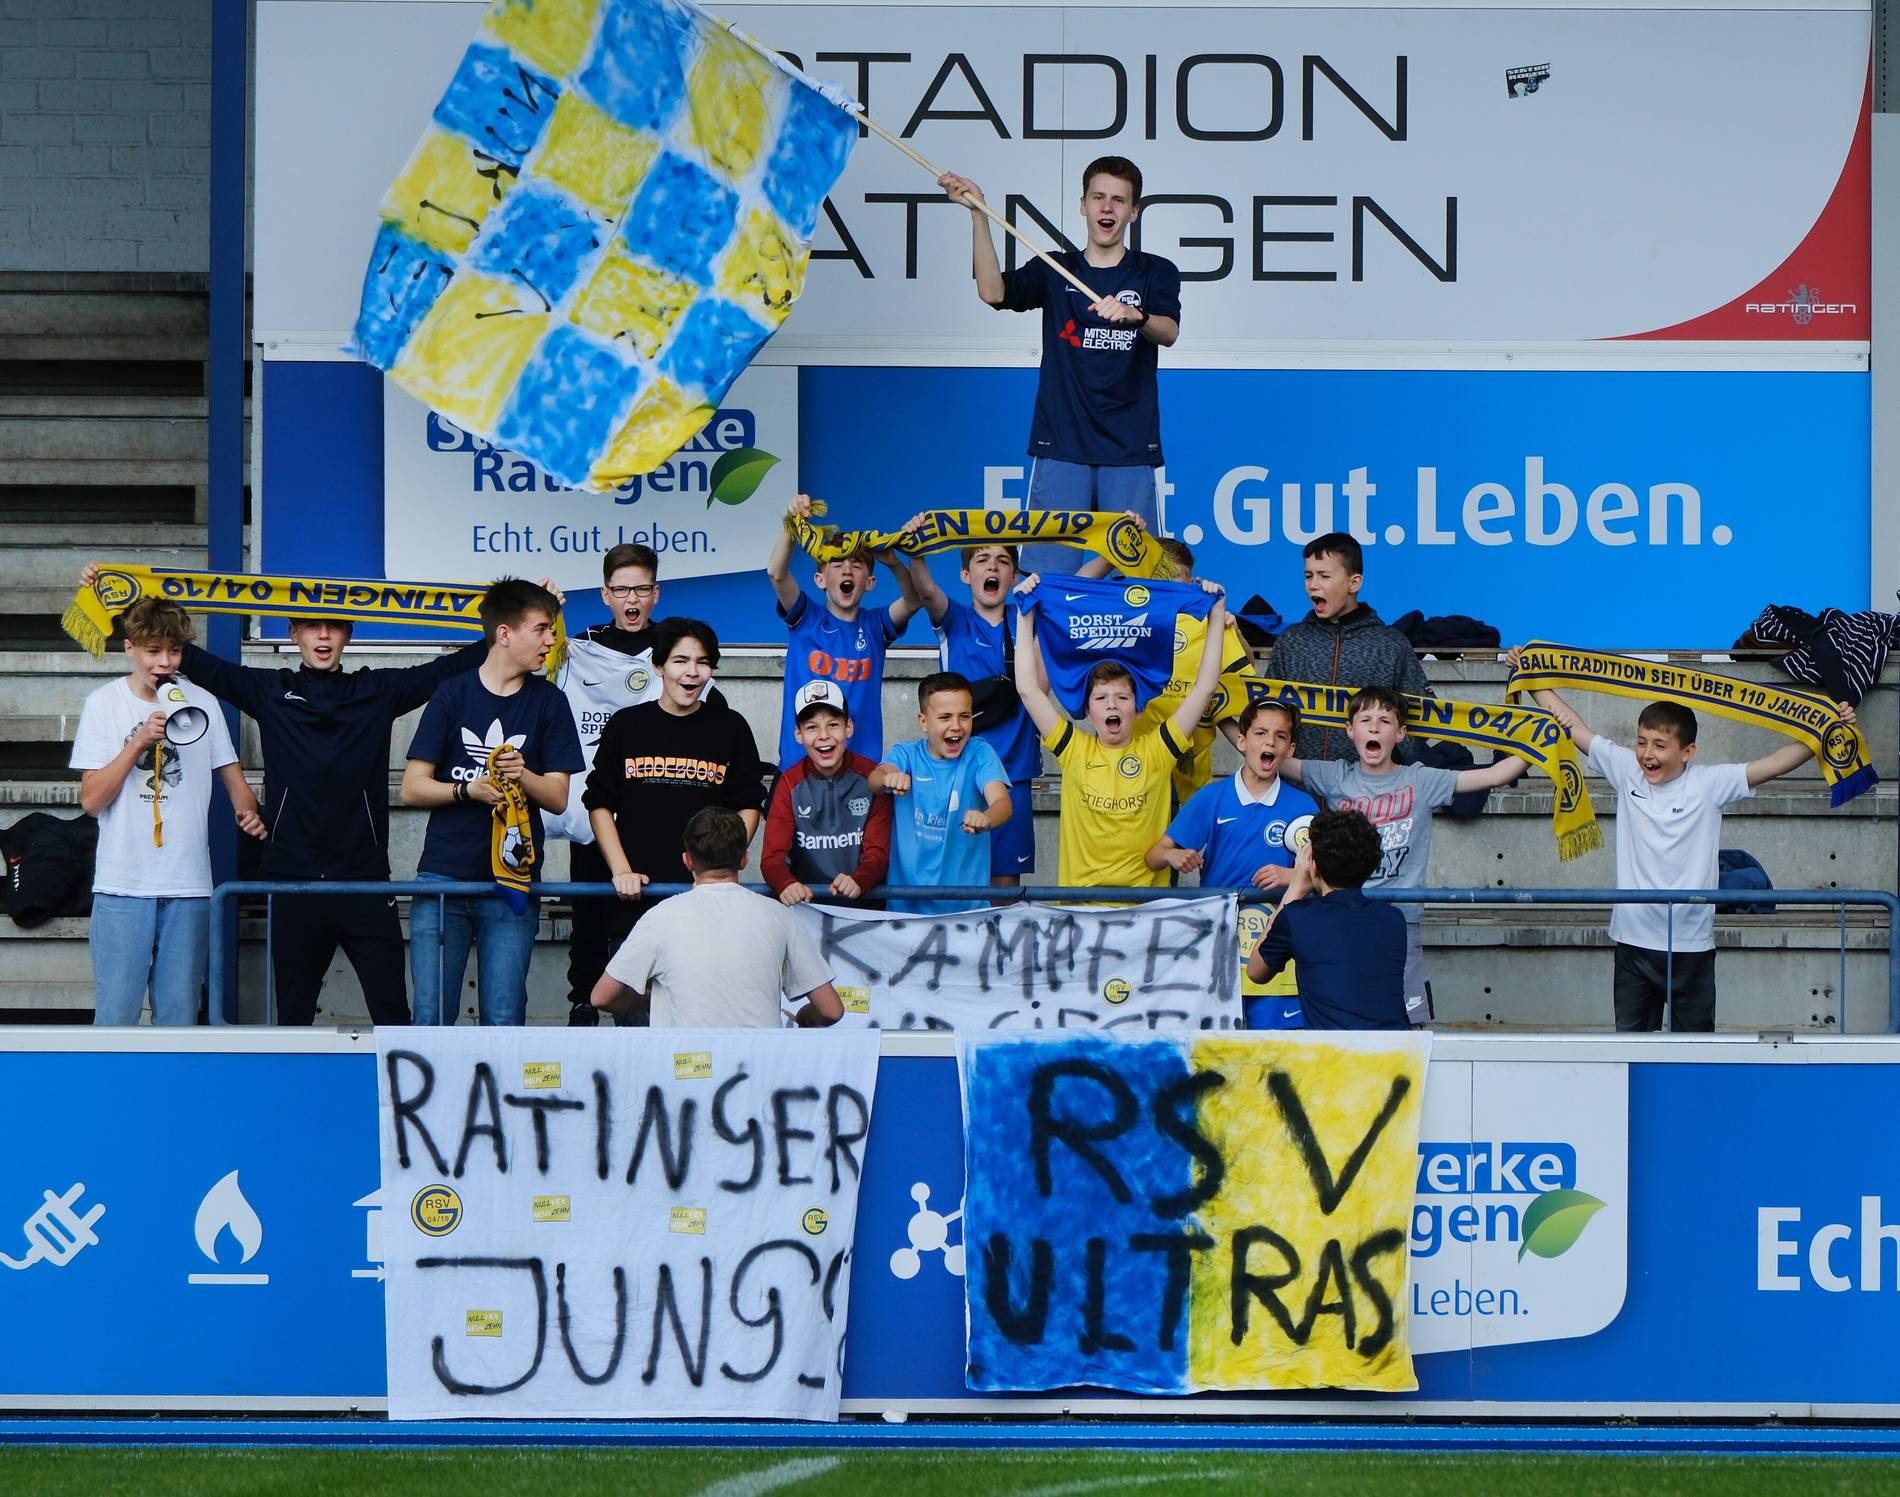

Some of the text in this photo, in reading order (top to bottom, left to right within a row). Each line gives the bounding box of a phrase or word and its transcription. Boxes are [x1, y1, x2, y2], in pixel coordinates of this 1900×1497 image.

[776, 51, 1408, 142] TADION
[1082, 338, 1133, 351] ELECTRIC
[472, 522, 543, 554] Echt.
[984, 509, 1095, 536] 04/19
[161, 576, 273, 601] 04/19
[1068, 614, 1124, 628] DORST
[1069, 626, 1153, 640] SPEDITION
[1651, 671, 1687, 691] SEIT
[1690, 673, 1733, 699] ÜBER
[1738, 687, 1765, 708] 110
[1767, 695, 1832, 730] JAHREN
[1468, 705, 1561, 748] 04/19
[1080, 791, 1149, 811] STIEGHORST
[386, 1048, 868, 1194] RATINGER
[1028, 1056, 1411, 1220] RSV
[425, 1198, 451, 1209] RSV
[984, 1224, 1406, 1359] ULTRAS
[1413, 1279, 1529, 1316] Leben.
